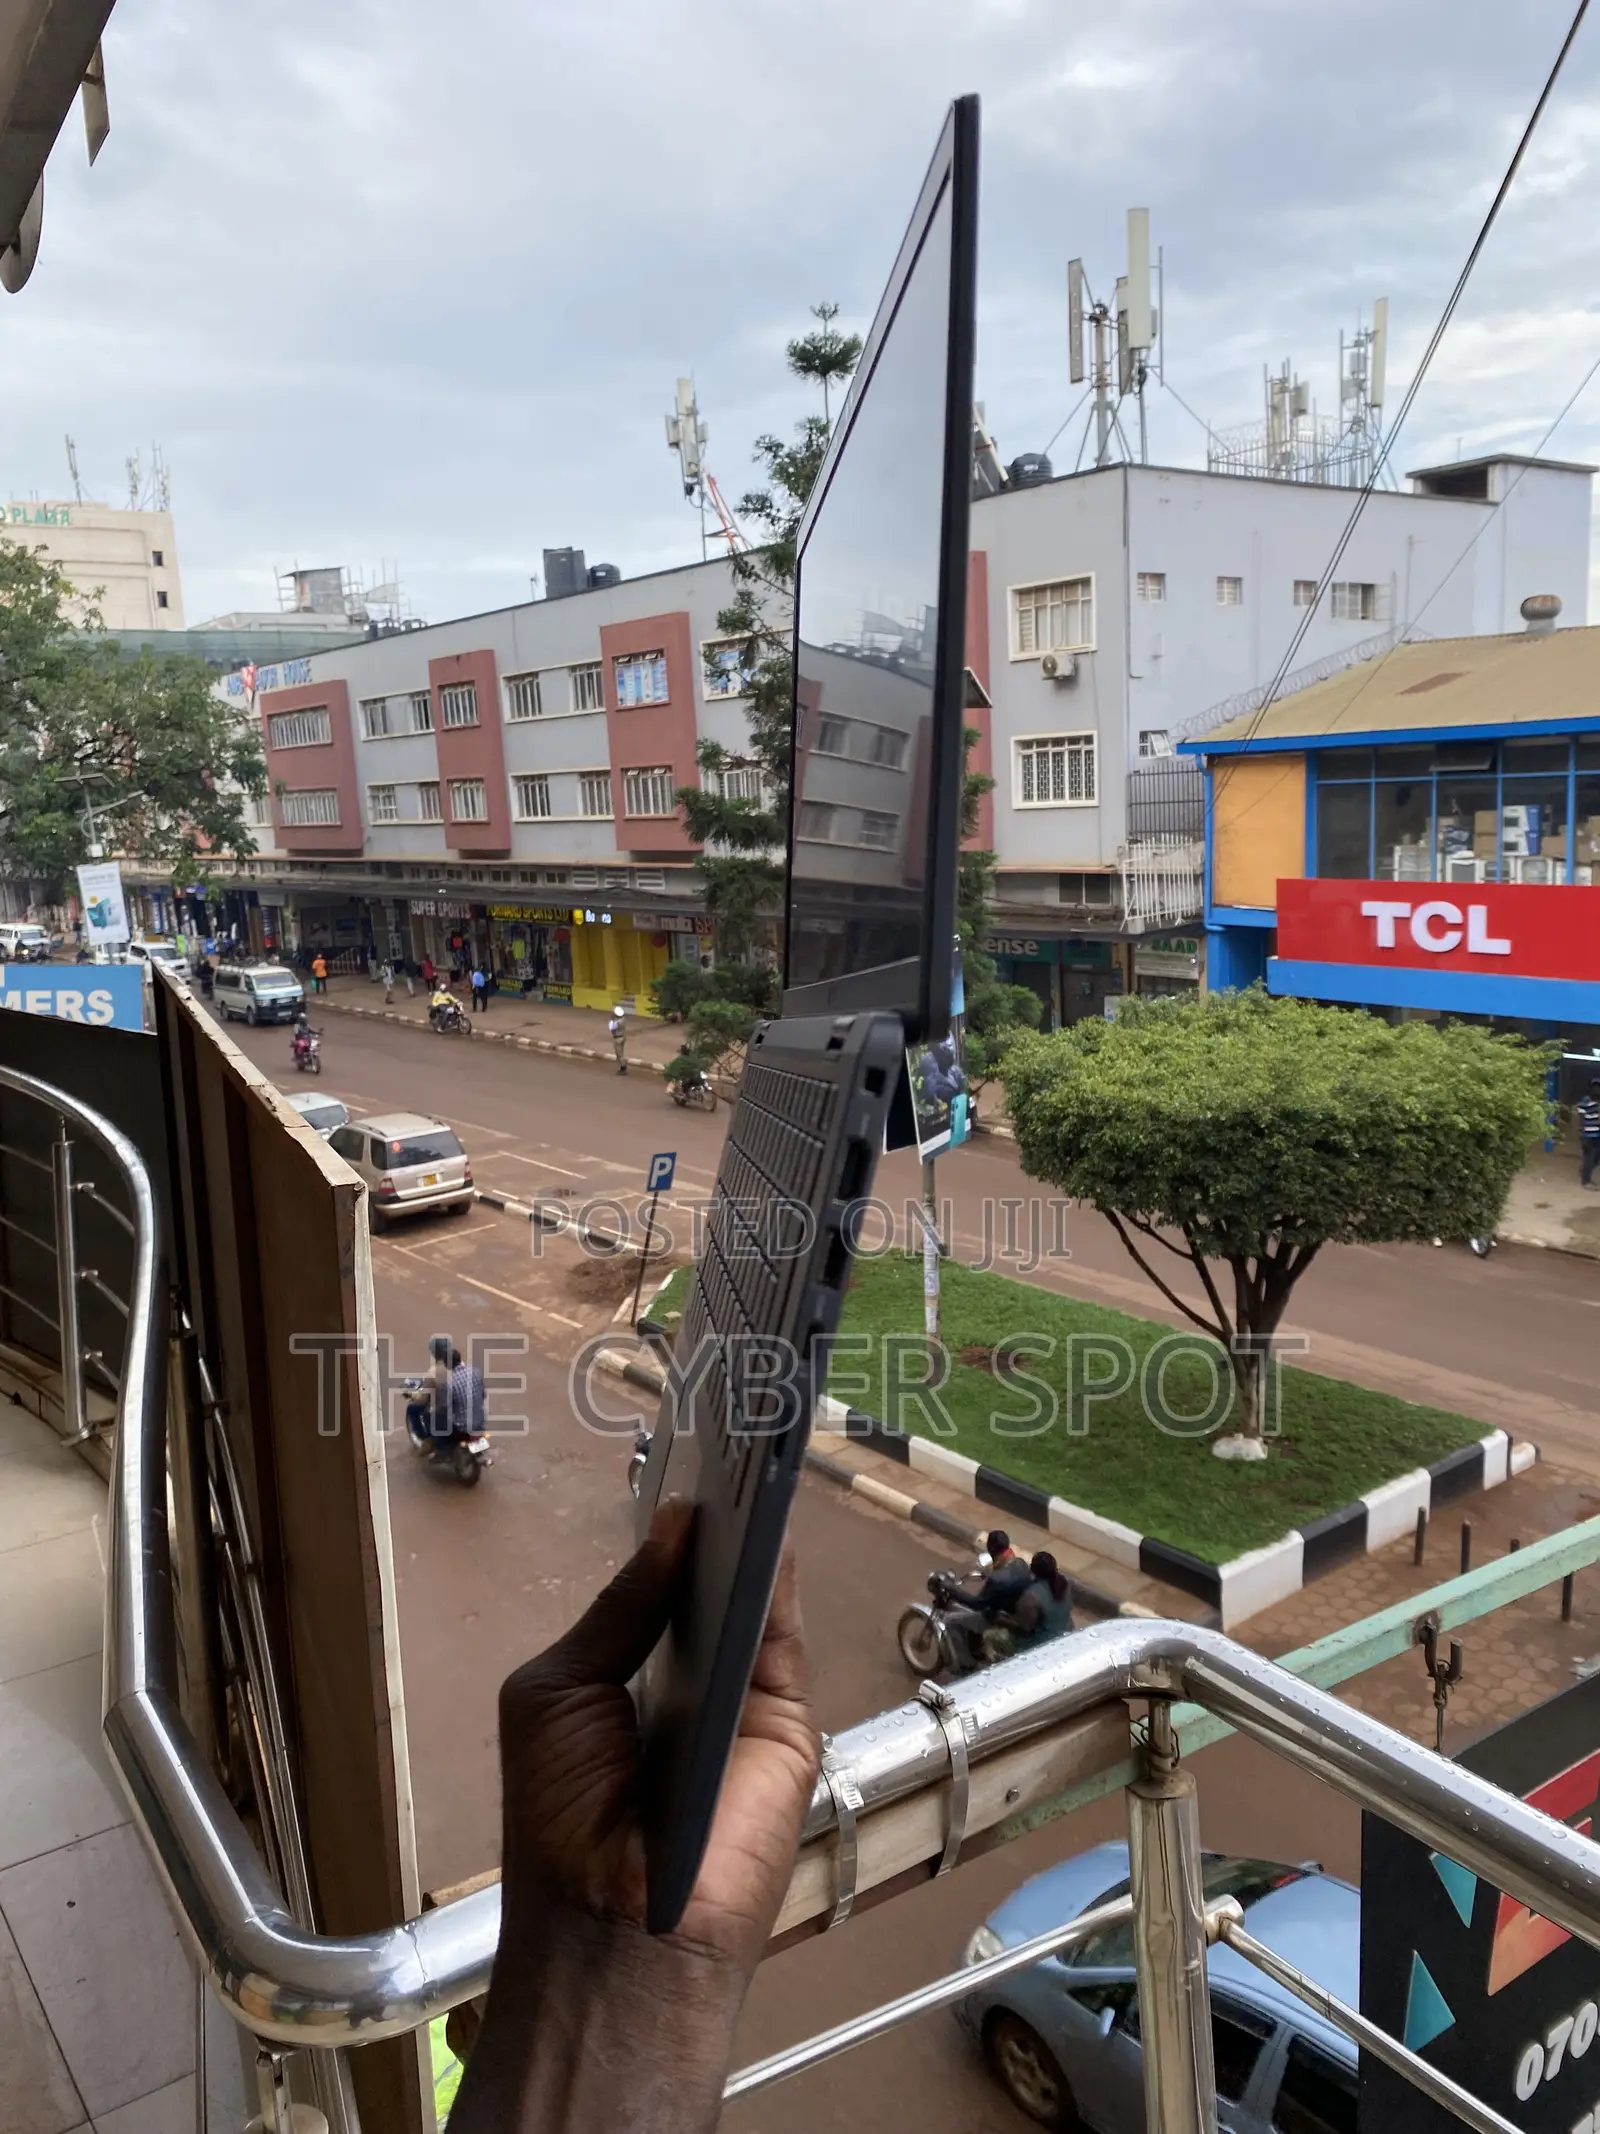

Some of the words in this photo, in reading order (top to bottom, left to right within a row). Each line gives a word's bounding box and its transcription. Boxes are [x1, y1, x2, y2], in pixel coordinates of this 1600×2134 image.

[12, 506, 72, 525] PLAZA
[411, 900, 436, 916] SUPER
[438, 902, 471, 919] SPORTS
[1361, 901, 1512, 955] TCL
[980, 938, 1039, 956] ense
[650, 1157, 673, 1188] P
[1516, 2001, 1600, 2102] 070
